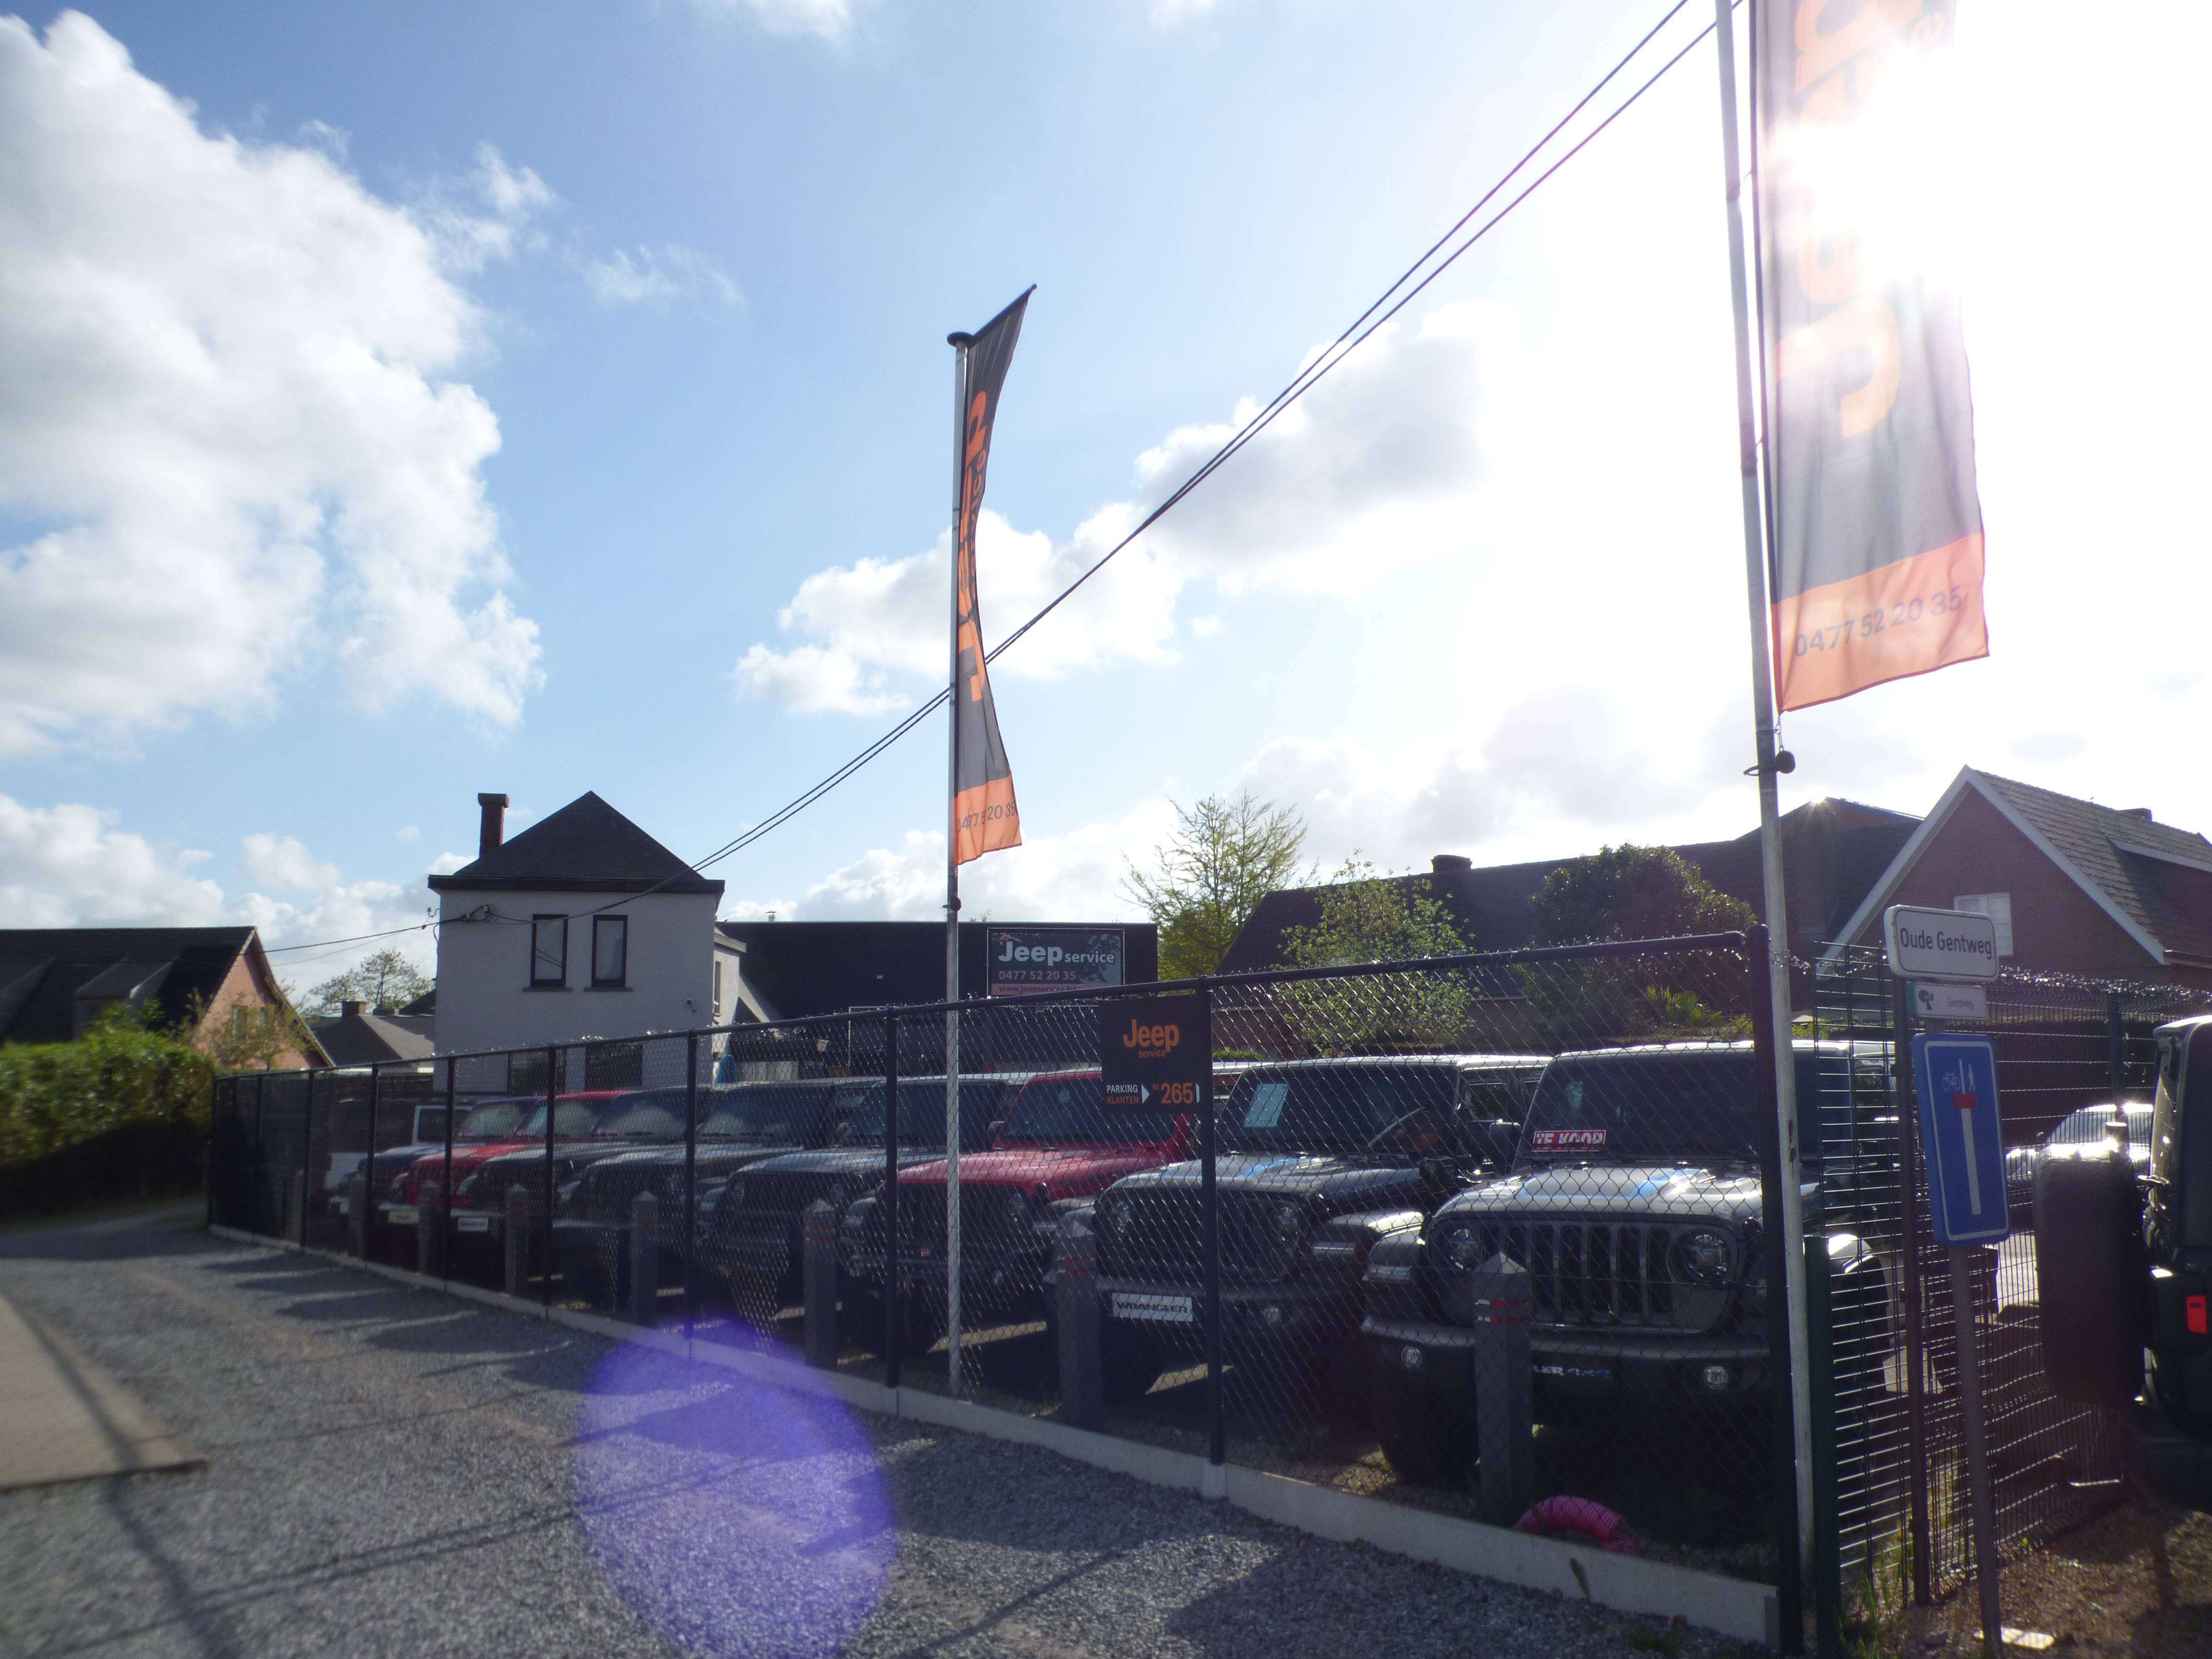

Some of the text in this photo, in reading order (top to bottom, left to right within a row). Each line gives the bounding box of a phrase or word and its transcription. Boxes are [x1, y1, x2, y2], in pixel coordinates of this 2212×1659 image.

[1794, 585, 1962, 657] 0477 52 20 35
[998, 941, 1115, 966] Jeep service
[1900, 927, 1992, 960] Oude Gentweg
[998, 970, 1076, 980] 0477 52 20 35
[1122, 1018, 1180, 1052] Jeep
[1138, 1048, 1166, 1058] service
[1106, 1084, 1138, 1094] PARKING
[1107, 1096, 1139, 1104] KLANTEN
[1161, 1082, 1194, 1105] 265
